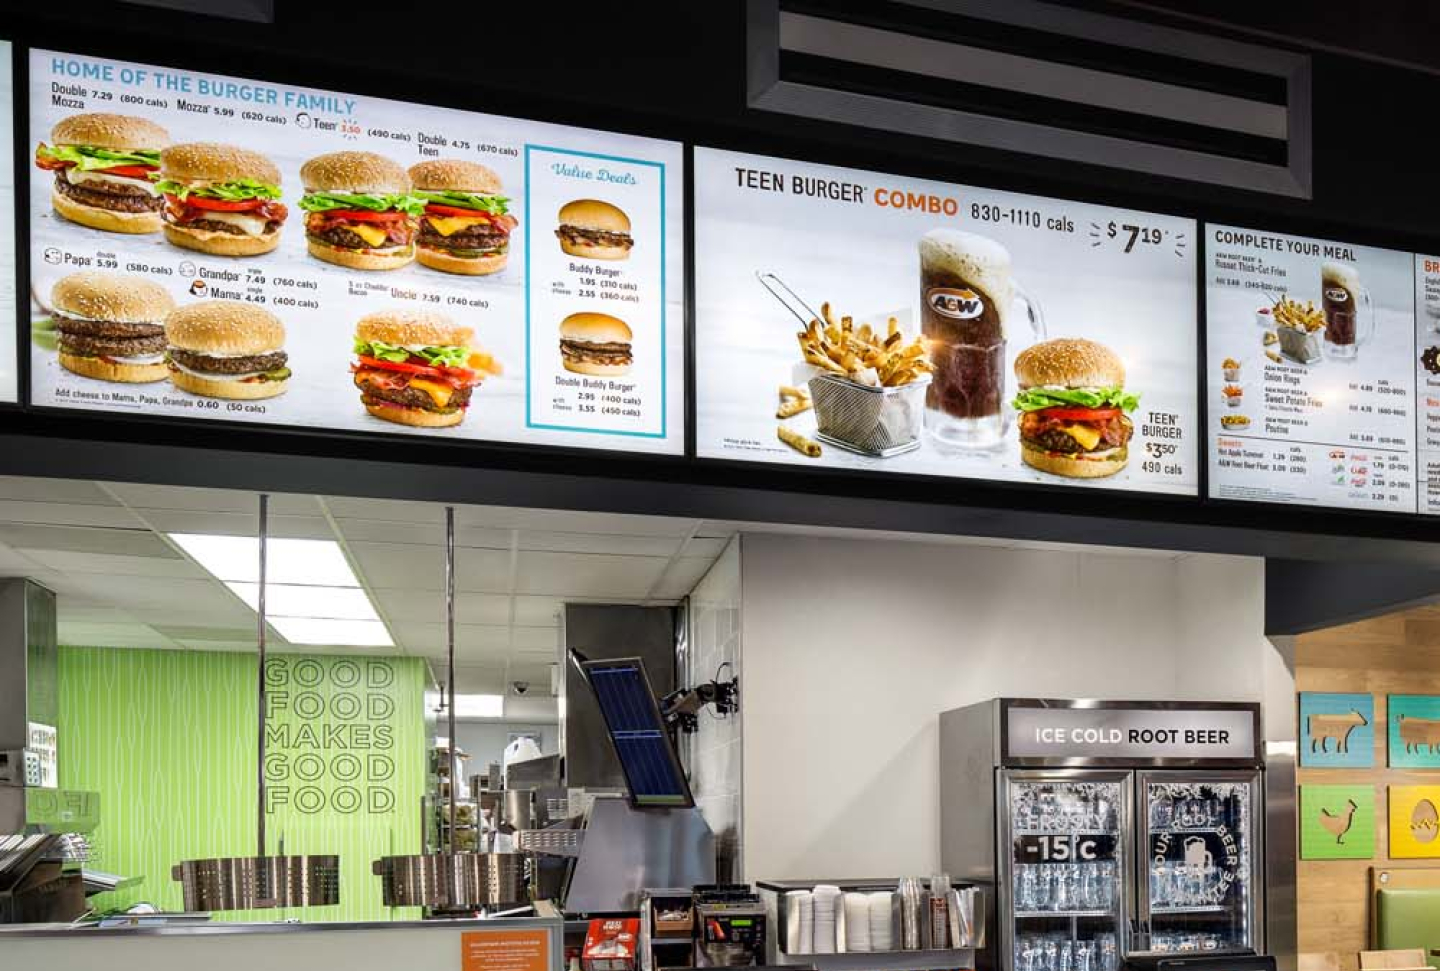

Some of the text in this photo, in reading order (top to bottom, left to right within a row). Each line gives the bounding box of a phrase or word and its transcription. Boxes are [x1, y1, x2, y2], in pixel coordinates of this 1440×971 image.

[51, 82, 168, 109] Double 7.29 (800 cals)
[52, 58, 356, 115] HOME OF THE BURGER FAMILY
[51, 95, 84, 110] Mozza
[176, 98, 209, 114] Mozza
[213, 107, 234, 118] 5.99
[314, 118, 337, 131] Teen
[418, 131, 447, 147] Double
[452, 140, 471, 150] 4.75
[418, 144, 439, 157] Teen
[551, 162, 636, 185] Value Deals
[735, 166, 785, 193] TEEN
[792, 176, 866, 204] BURGER
[874, 187, 958, 217] COMBO
[971, 202, 1041, 228] 830-1110
[1046, 215, 1074, 234] cals
[1215, 230, 1357, 262] COMPLETE YOUR MEAL
[64, 252, 92, 267] Papa
[97, 258, 118, 270] 5.99
[569, 262, 621, 279] Buddy Burger
[199, 267, 240, 282] Grandpa
[245, 275, 266, 285] 7.49
[211, 287, 242, 300] Mama
[245, 295, 266, 304] 4.49
[391, 287, 417, 300] Uncle
[555, 376, 635, 393] Double Buddy Burger
[55, 388, 70, 398] Add
[72, 390, 99, 400] cheese
[101, 393, 110, 401] to
[196, 401, 219, 411] 0.60
[1148, 411, 1178, 426] TEEN
[1141, 424, 1183, 440] BURGER
[1141, 461, 1183, 475] 490 cals
[264, 657, 395, 689] GOOD
[264, 690, 396, 721] FOOD
[264, 723, 395, 750] MAKES
[1035, 727, 1230, 744] ICE COLD ROOT BEER
[264, 752, 396, 783] GOOD
[265, 785, 396, 814] FOOD
[1154, 814, 1239, 867] OUR ROOT BEER
